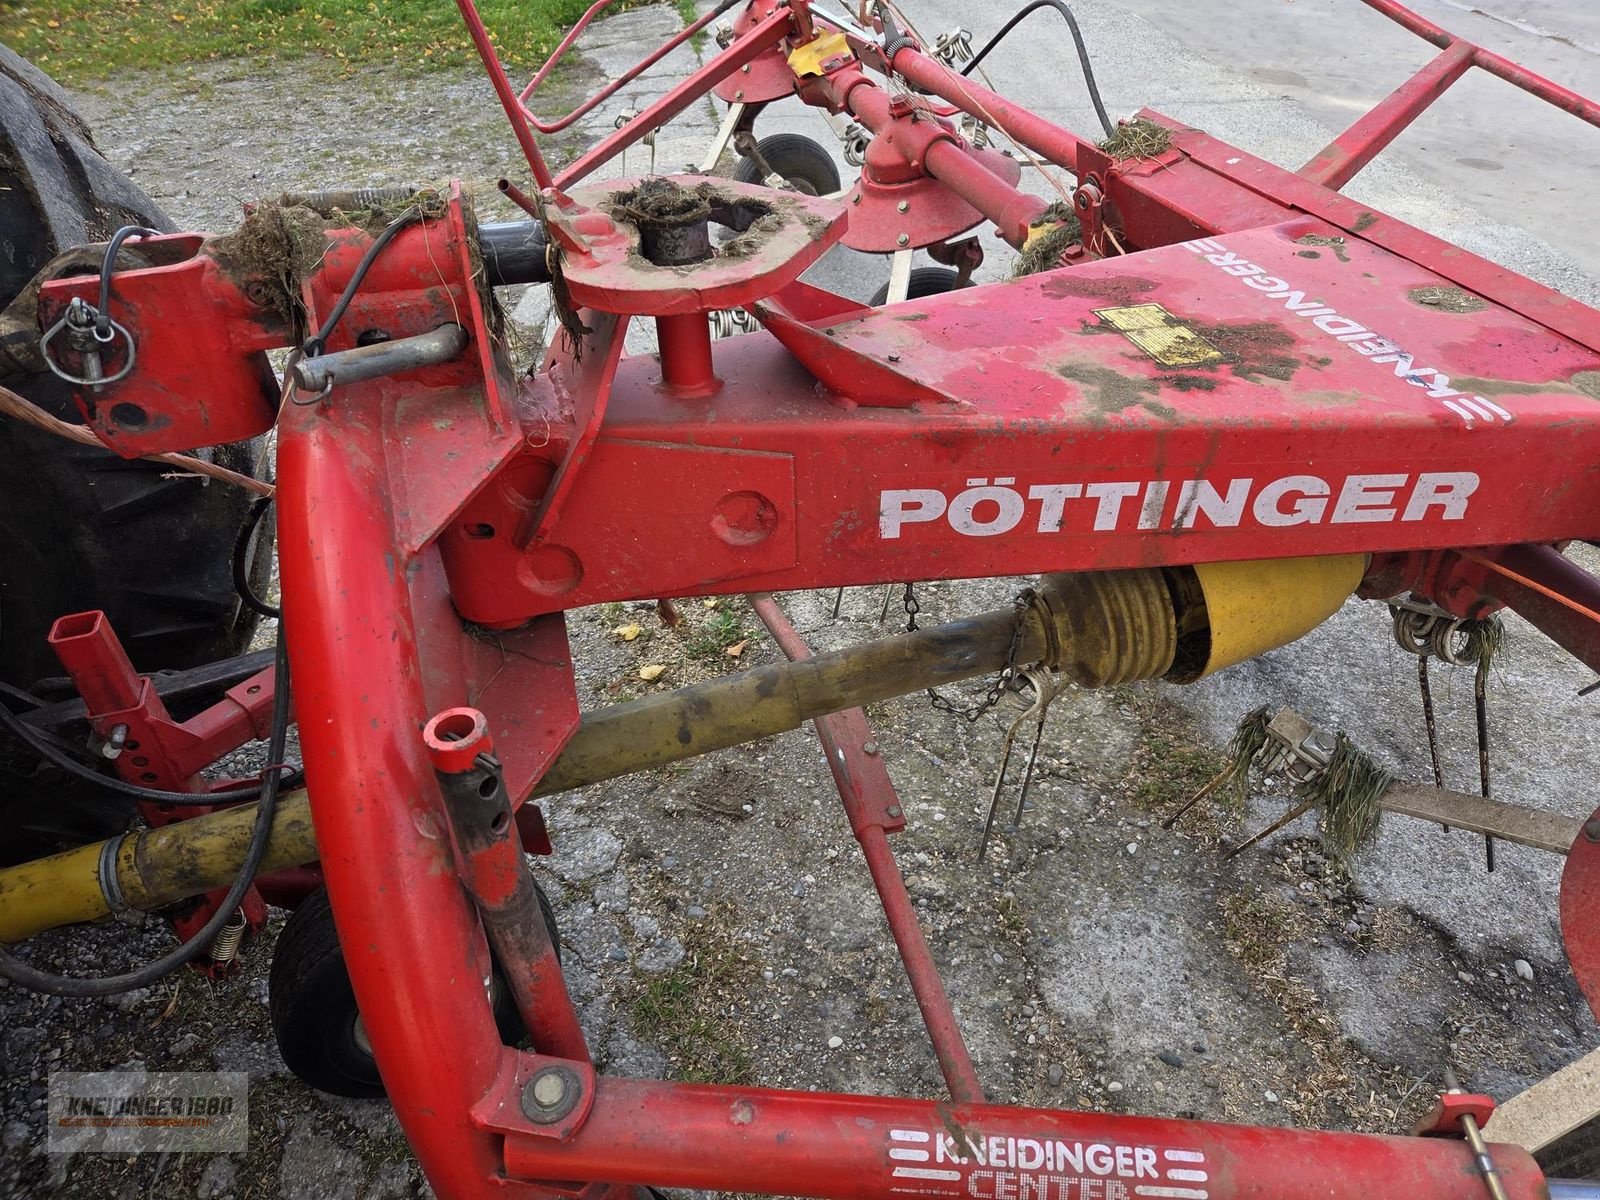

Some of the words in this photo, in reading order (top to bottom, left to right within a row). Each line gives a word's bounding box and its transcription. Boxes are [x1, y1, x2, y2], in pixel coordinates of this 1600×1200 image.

[1204, 252, 1466, 398] KNEIDINGER
[879, 471, 1480, 539] PÖTTINGER
[936, 1132, 1159, 1179] KNEIDINGER
[967, 1169, 1131, 1200] CENTER
